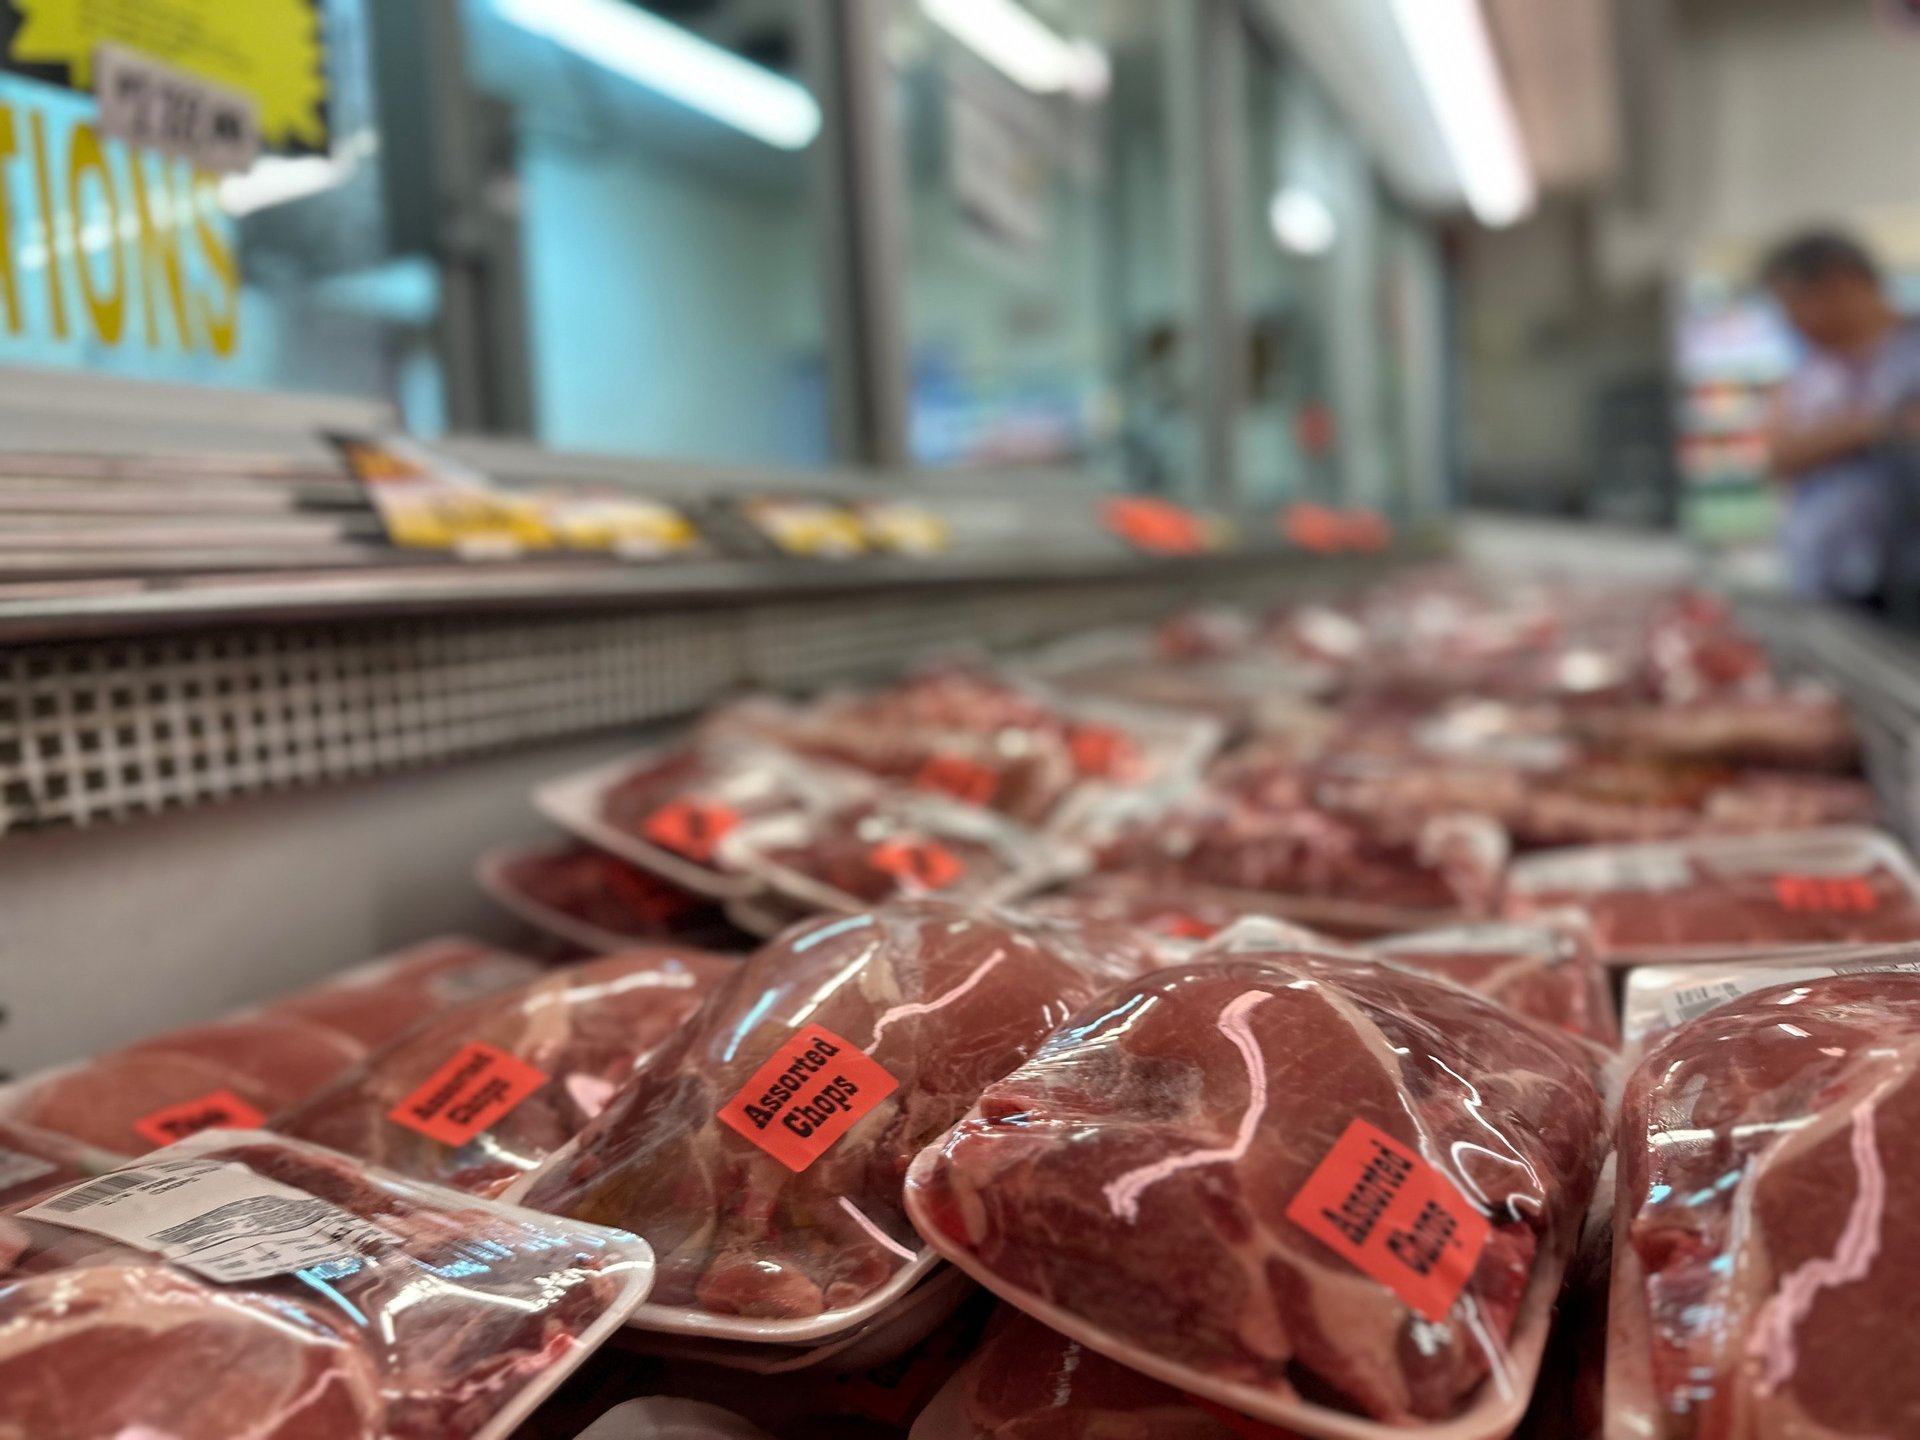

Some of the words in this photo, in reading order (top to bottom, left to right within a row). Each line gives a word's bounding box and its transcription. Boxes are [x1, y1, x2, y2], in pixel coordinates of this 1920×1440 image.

[742, 1036, 841, 1130] Assorted
[781, 1075, 859, 1138] Chops
[1320, 1138, 1414, 1246] Assorted
[1385, 1199, 1463, 1276] Chops
